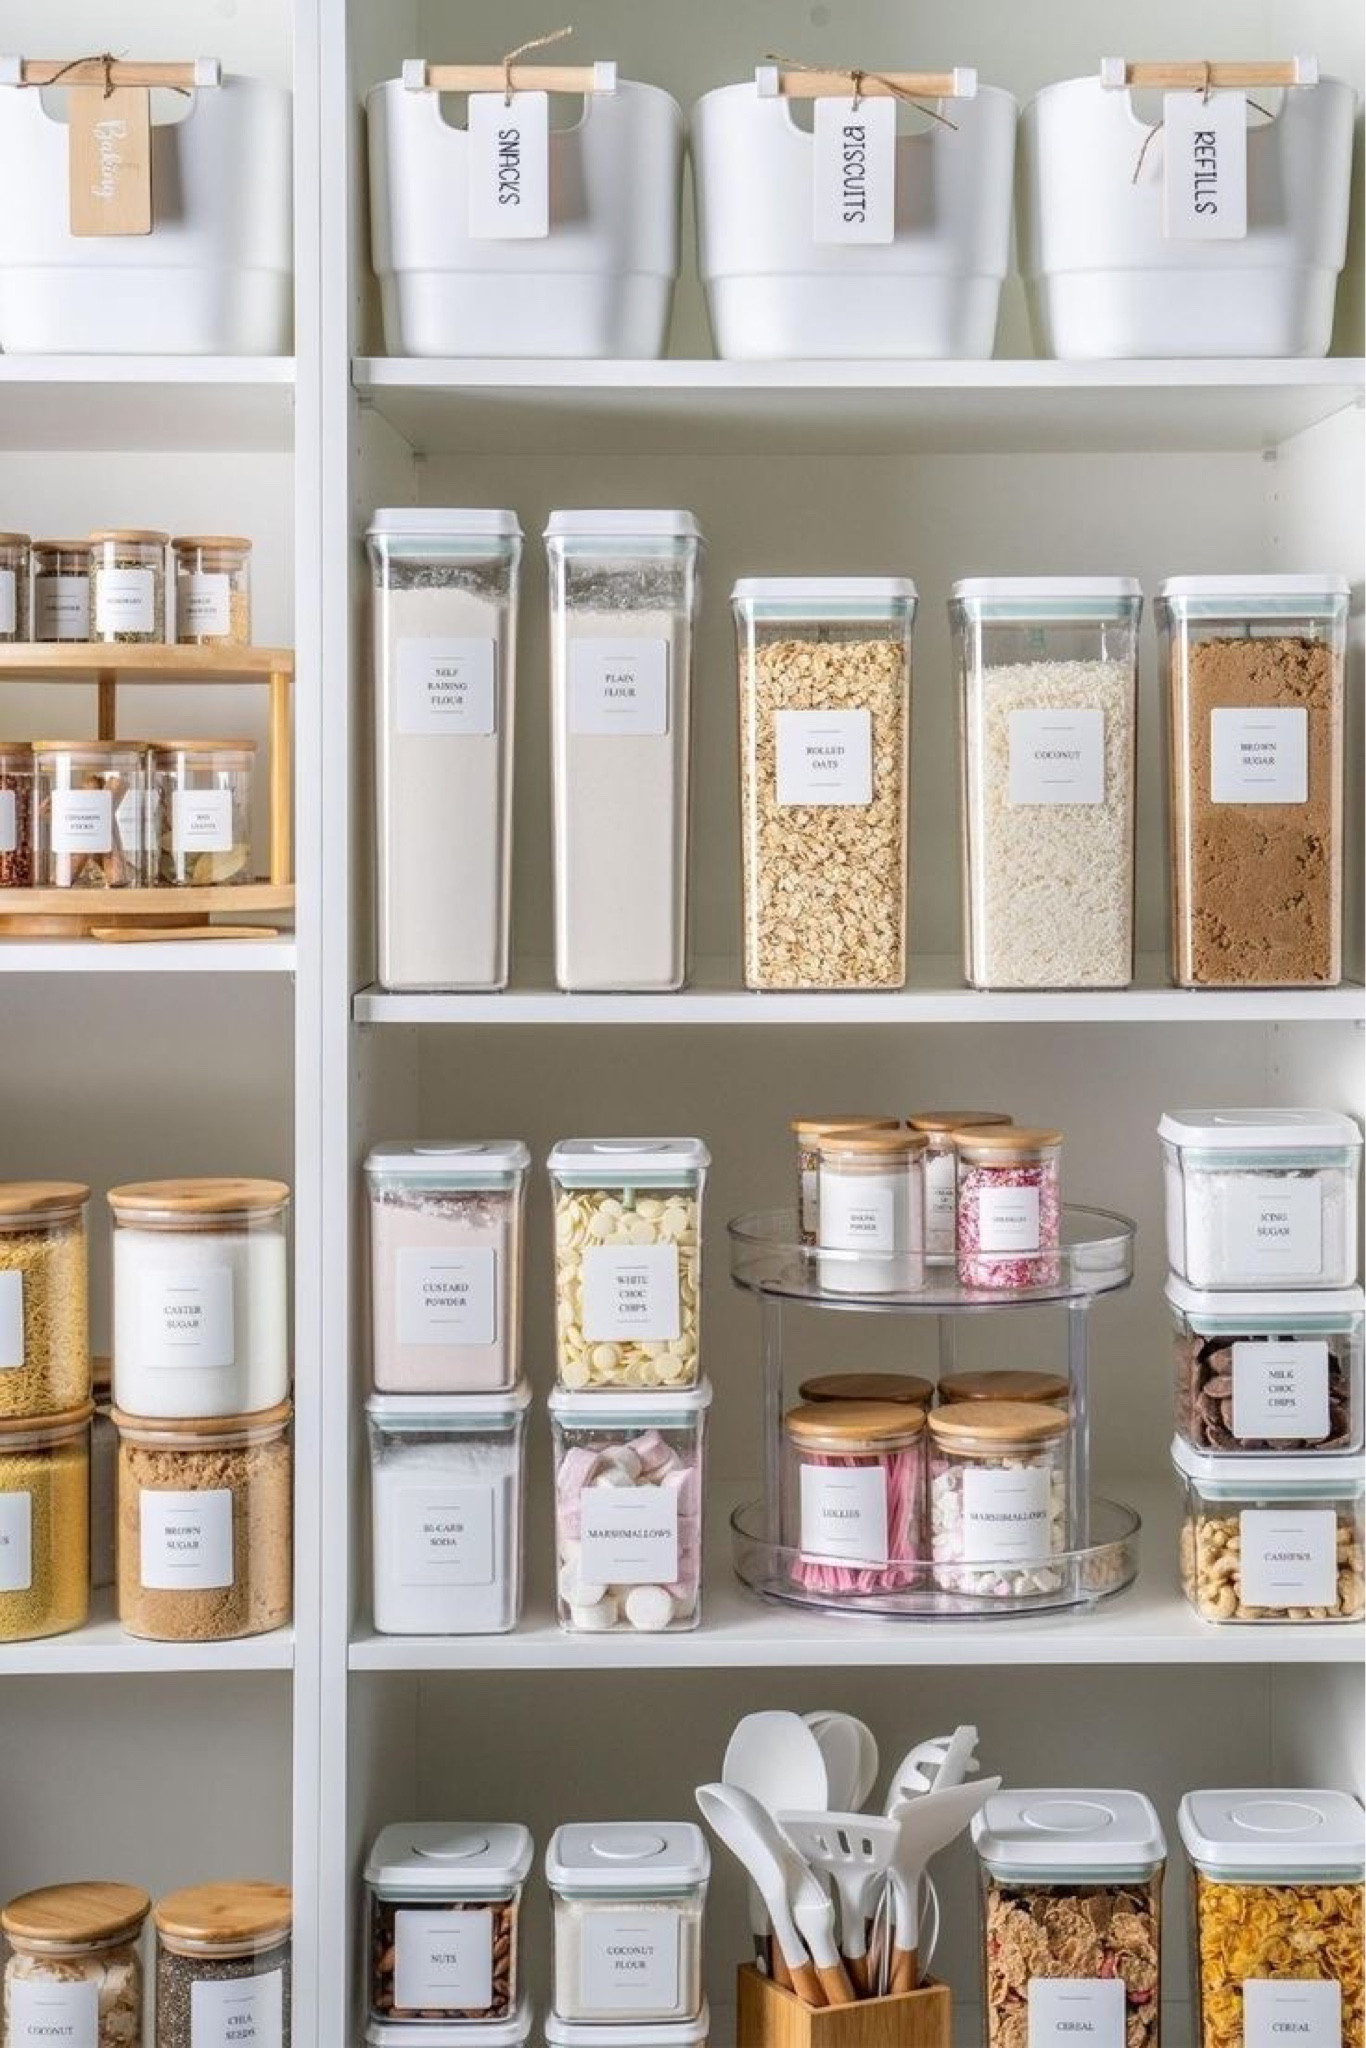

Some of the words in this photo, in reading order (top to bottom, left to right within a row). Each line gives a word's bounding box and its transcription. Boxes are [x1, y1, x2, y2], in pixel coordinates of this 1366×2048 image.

[498, 129, 521, 206] SNACKS
[843, 125, 866, 223] BISCUITS
[1194, 130, 1218, 215] REFILLS
[435, 669, 458, 678] SELF
[605, 674, 634, 683] PLAIN
[427, 682, 469, 691] RAISING
[604, 688, 637, 697] FLOUR
[431, 696, 464, 705] FLOUR
[806, 746, 845, 755] ROLLED
[1240, 743, 1277, 751] BROWN
[1034, 750, 1081, 759] COCONUT
[811, 760, 839, 769] OATS
[1242, 757, 1276, 765] SUGAR
[1260, 1212, 1288, 1222] ICING
[1257, 1226, 1290, 1236] SUGAR
[616, 1275, 649, 1284] WHITE
[422, 1283, 470, 1292] CUSTARD
[618, 1290, 647, 1298] CHOC
[425, 1297, 467, 1306] POWDER
[164, 1305, 203, 1314] CASTER
[618, 1303, 648, 1312] CHIPS
[167, 1319, 200, 1328] SUGAR
[1268, 1370, 1295, 1379] MILK
[1268, 1384, 1296, 1393] CHOC
[1268, 1398, 1297, 1407] CHIPS
[822, 1509, 861, 1519] LOLLIES
[969, 1510, 1048, 1522] MARSHMALLOWS
[164, 1526, 202, 1535] BROWN
[424, 1524, 464, 1533] BI-CARB
[587, 1529, 672, 1539] MARSHMALLOWS
[166, 1540, 200, 1549] SUGAR
[430, 1538, 458, 1546] SODA
[1263, 1551, 1312, 1562] CASHEWS
[606, 1945, 655, 1955] COCONUT
[430, 1954, 457, 1964] NUTS
[615, 1960, 646, 1969] FLOUR
[227, 2013, 253, 2025] CHIA
[27, 2026, 74, 2036] COCONUT
[1056, 2021, 1096, 2032] CEREAL
[1272, 2021, 1311, 2032] CEREAL
[225, 2028, 256, 2040] SEEDS
